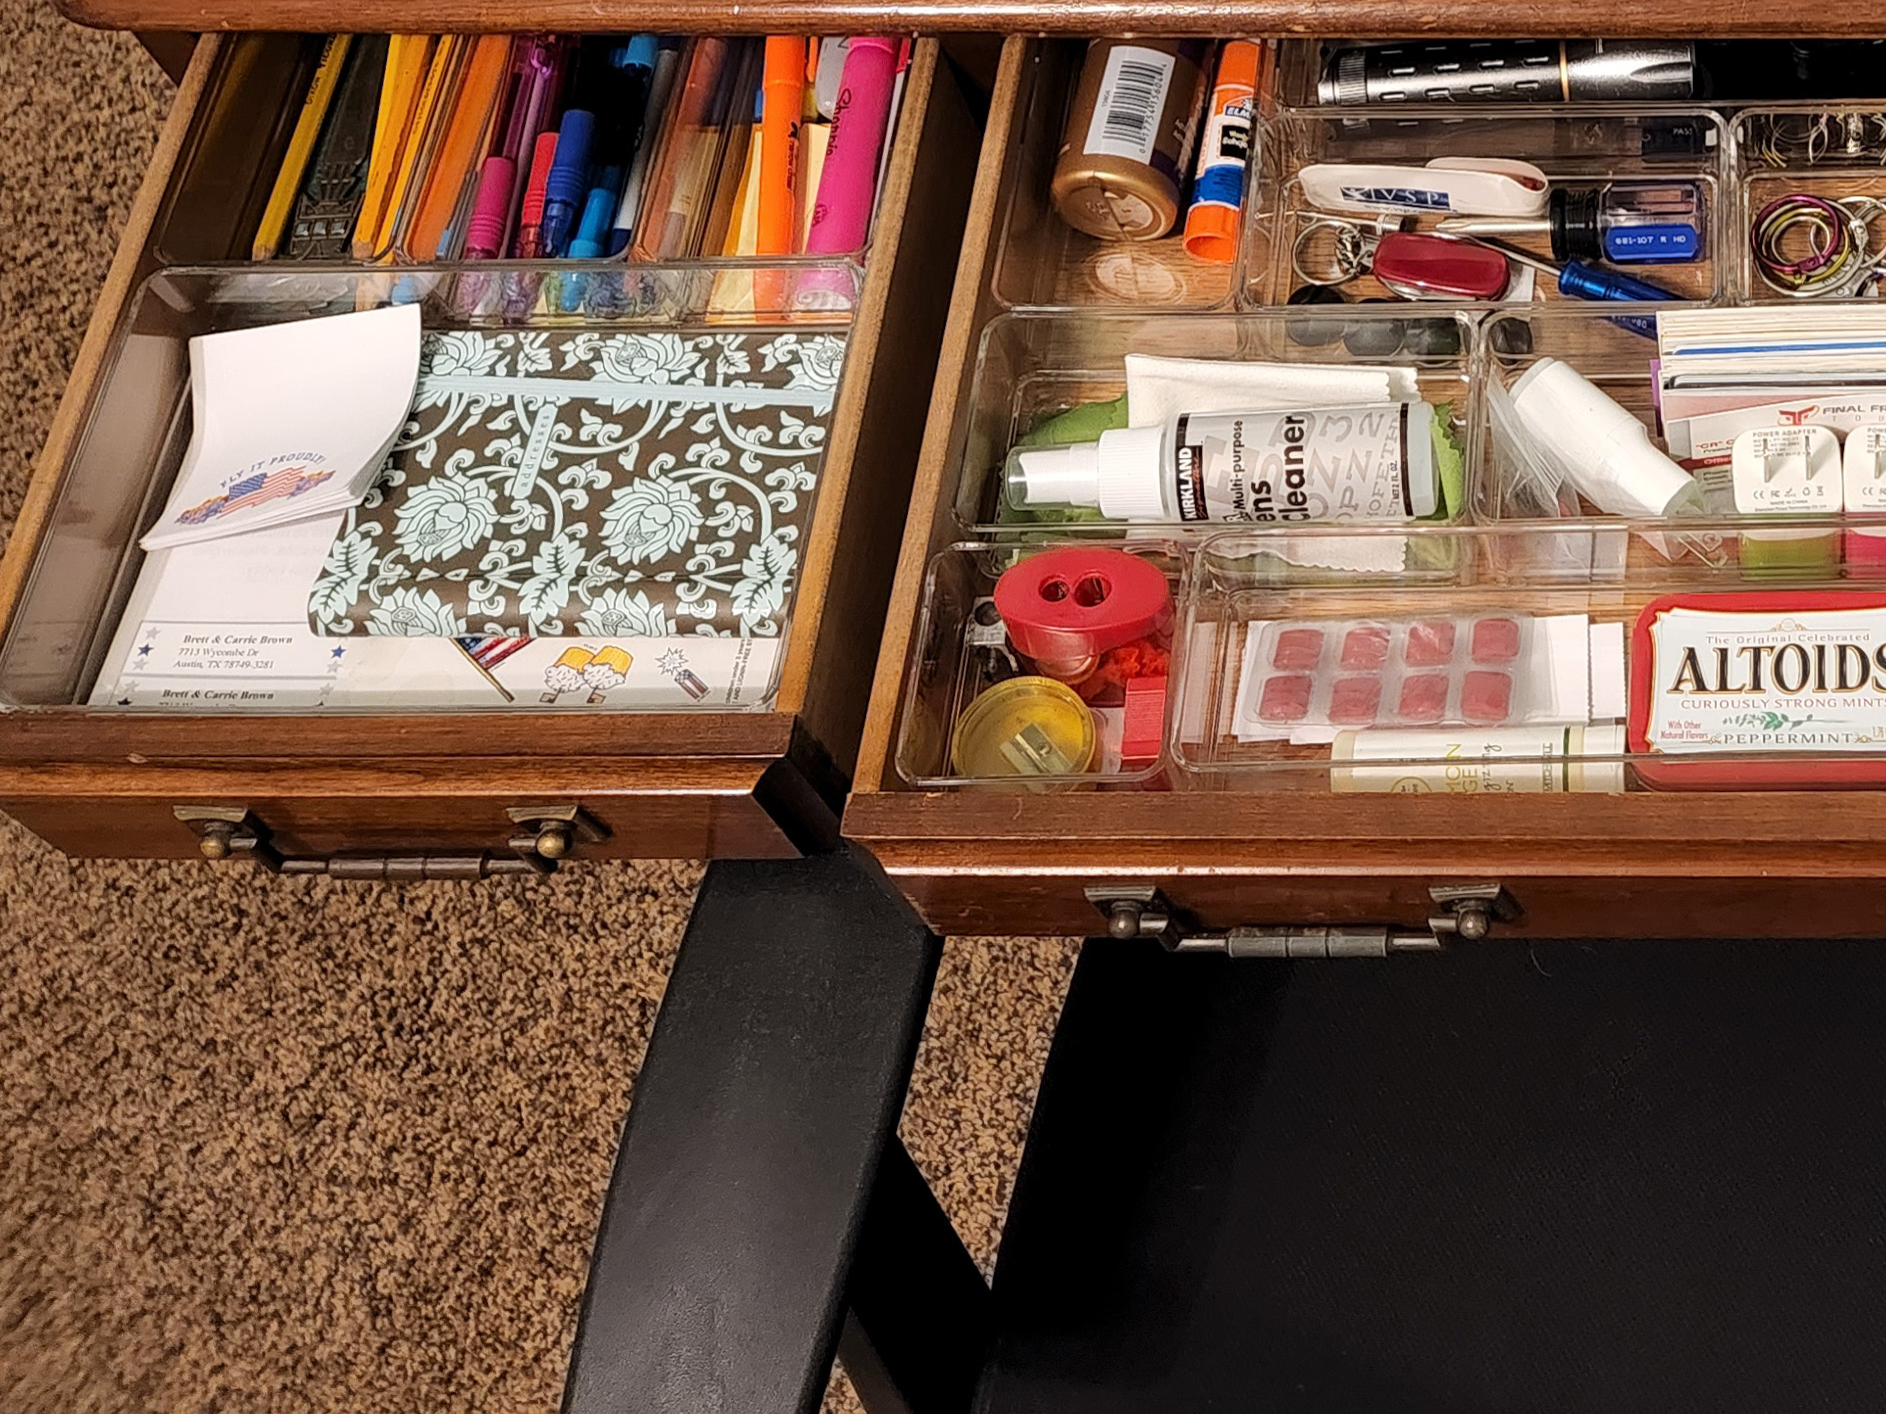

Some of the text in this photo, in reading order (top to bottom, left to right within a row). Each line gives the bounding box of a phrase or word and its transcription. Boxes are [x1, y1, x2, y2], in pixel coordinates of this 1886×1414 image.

[1823, 405, 1867, 415] FINAL
[1229, 419, 1247, 510] Multi-purpose
[1178, 446, 1198, 521] KIRKLAND
[1250, 479, 1277, 523] ens
[183, 634, 293, 644] Brett & Carrie Brown
[1707, 632, 1872, 646] The Original Celebrated
[178, 647, 260, 659] 7713 Wycombe Dr
[173, 659, 275, 670] Austin, TX 78749-3281
[161, 689, 275, 700] Brett & Carrie Brown
[1680, 698, 1772, 711] CURIOUSLY
[1774, 697, 1838, 709] STRONG
[1667, 719, 1702, 731] With Other
[1660, 729, 1709, 740] Natural Flavors
[1723, 733, 1856, 745] PEPPERMINT
